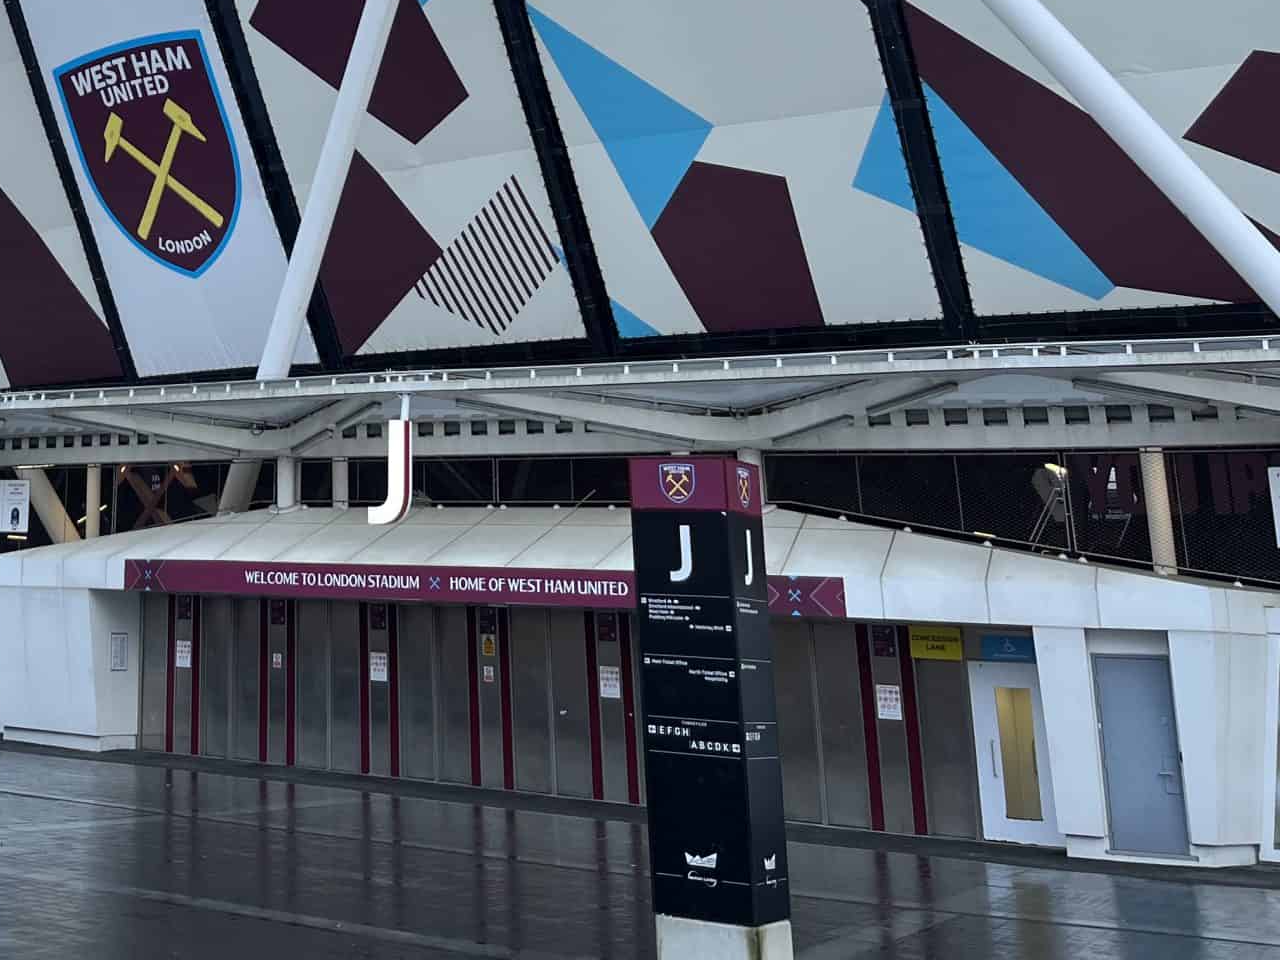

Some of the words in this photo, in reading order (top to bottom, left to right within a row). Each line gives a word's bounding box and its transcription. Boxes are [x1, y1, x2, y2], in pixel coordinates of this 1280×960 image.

[70, 57, 128, 97] WEST
[131, 45, 192, 78] HAM
[100, 75, 170, 107] UNITED
[158, 230, 213, 254] LONDON
[368, 420, 411, 524] J
[670, 525, 692, 581] J
[745, 529, 753, 585] J
[245, 570, 299, 585] WELCOME
[301, 573, 316, 586] TO
[318, 573, 366, 588] LONDON
[368, 574, 420, 589] STADIUM
[449, 576, 486, 591] HOME
[488, 577, 506, 592] OF
[508, 578, 542, 593] WEST
[545, 579, 575, 594] HAM
[577, 580, 628, 596] UNITED
